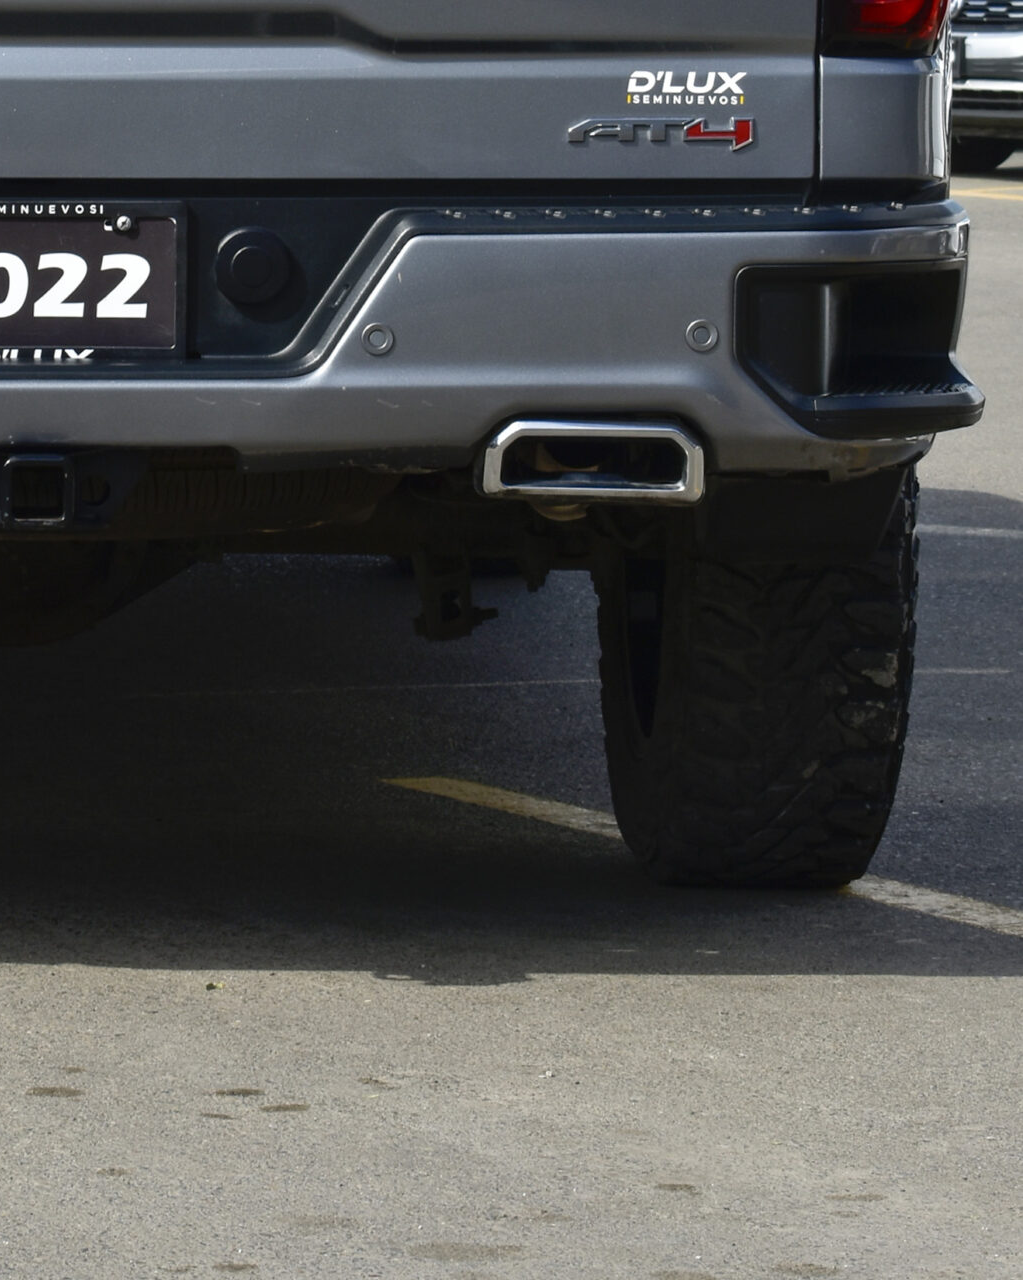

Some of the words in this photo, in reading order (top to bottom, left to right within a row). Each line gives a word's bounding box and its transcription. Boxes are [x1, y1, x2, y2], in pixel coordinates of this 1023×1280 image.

[628, 70, 747, 94] D'LUX
[633, 94, 738, 105] SEMINUEVOS
[568, 116, 755, 151] AT4
